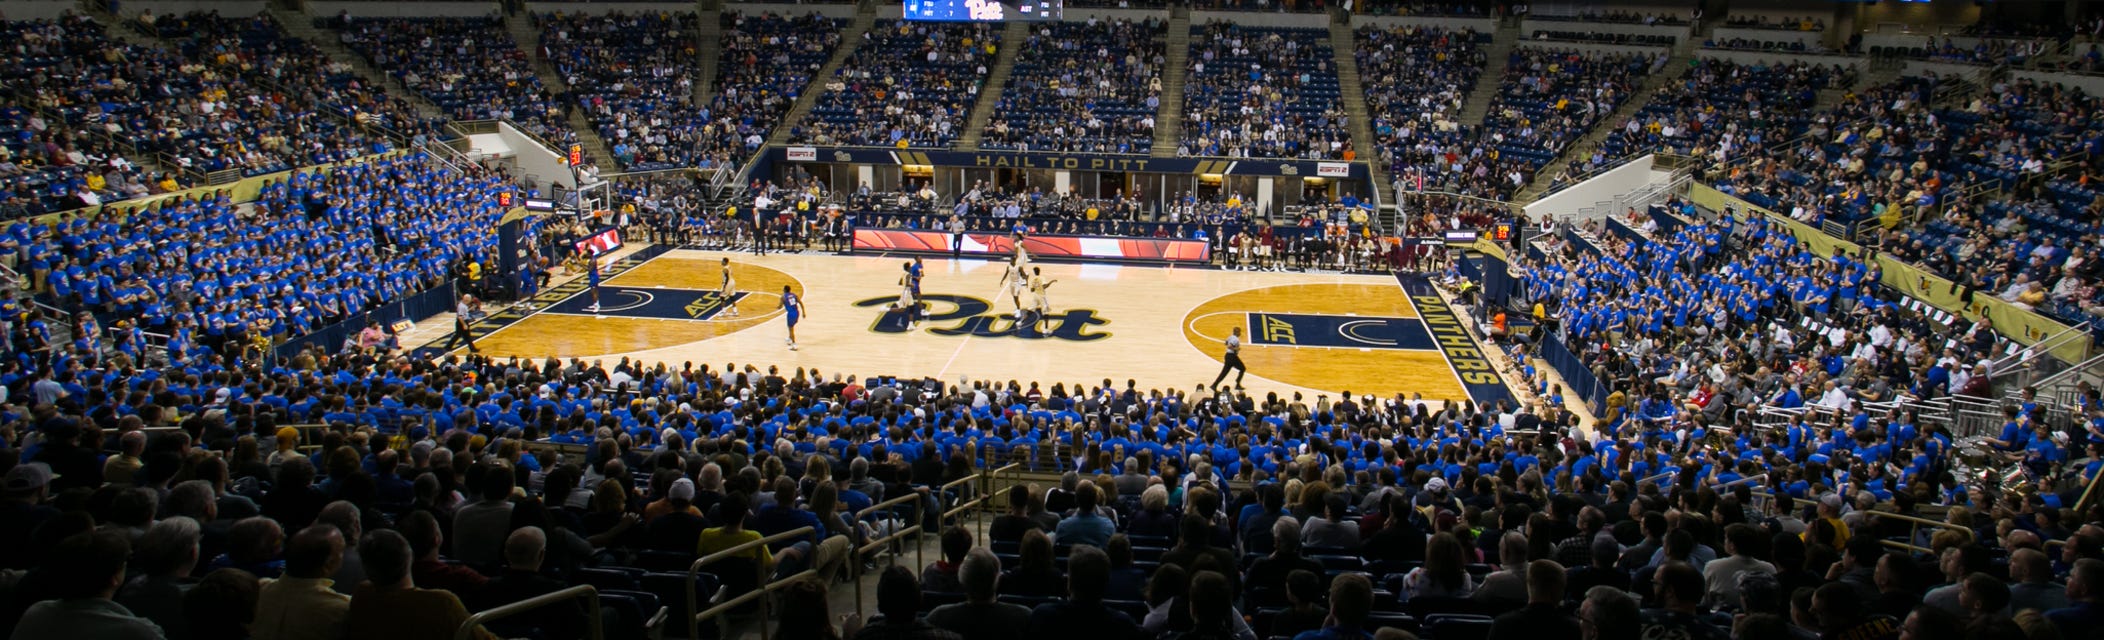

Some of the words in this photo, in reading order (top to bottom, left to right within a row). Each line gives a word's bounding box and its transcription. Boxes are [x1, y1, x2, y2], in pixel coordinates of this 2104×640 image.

[1020, 5, 1032, 13] AST
[976, 155, 1035, 167] HAIL
[1046, 157, 1078, 169] TO
[1091, 159, 1149, 170] PITT
[684, 292, 721, 316] ACC
[850, 293, 1113, 341] Pitt
[1268, 316, 1297, 345] ACC
[1413, 295, 1500, 385] PANTHERS
